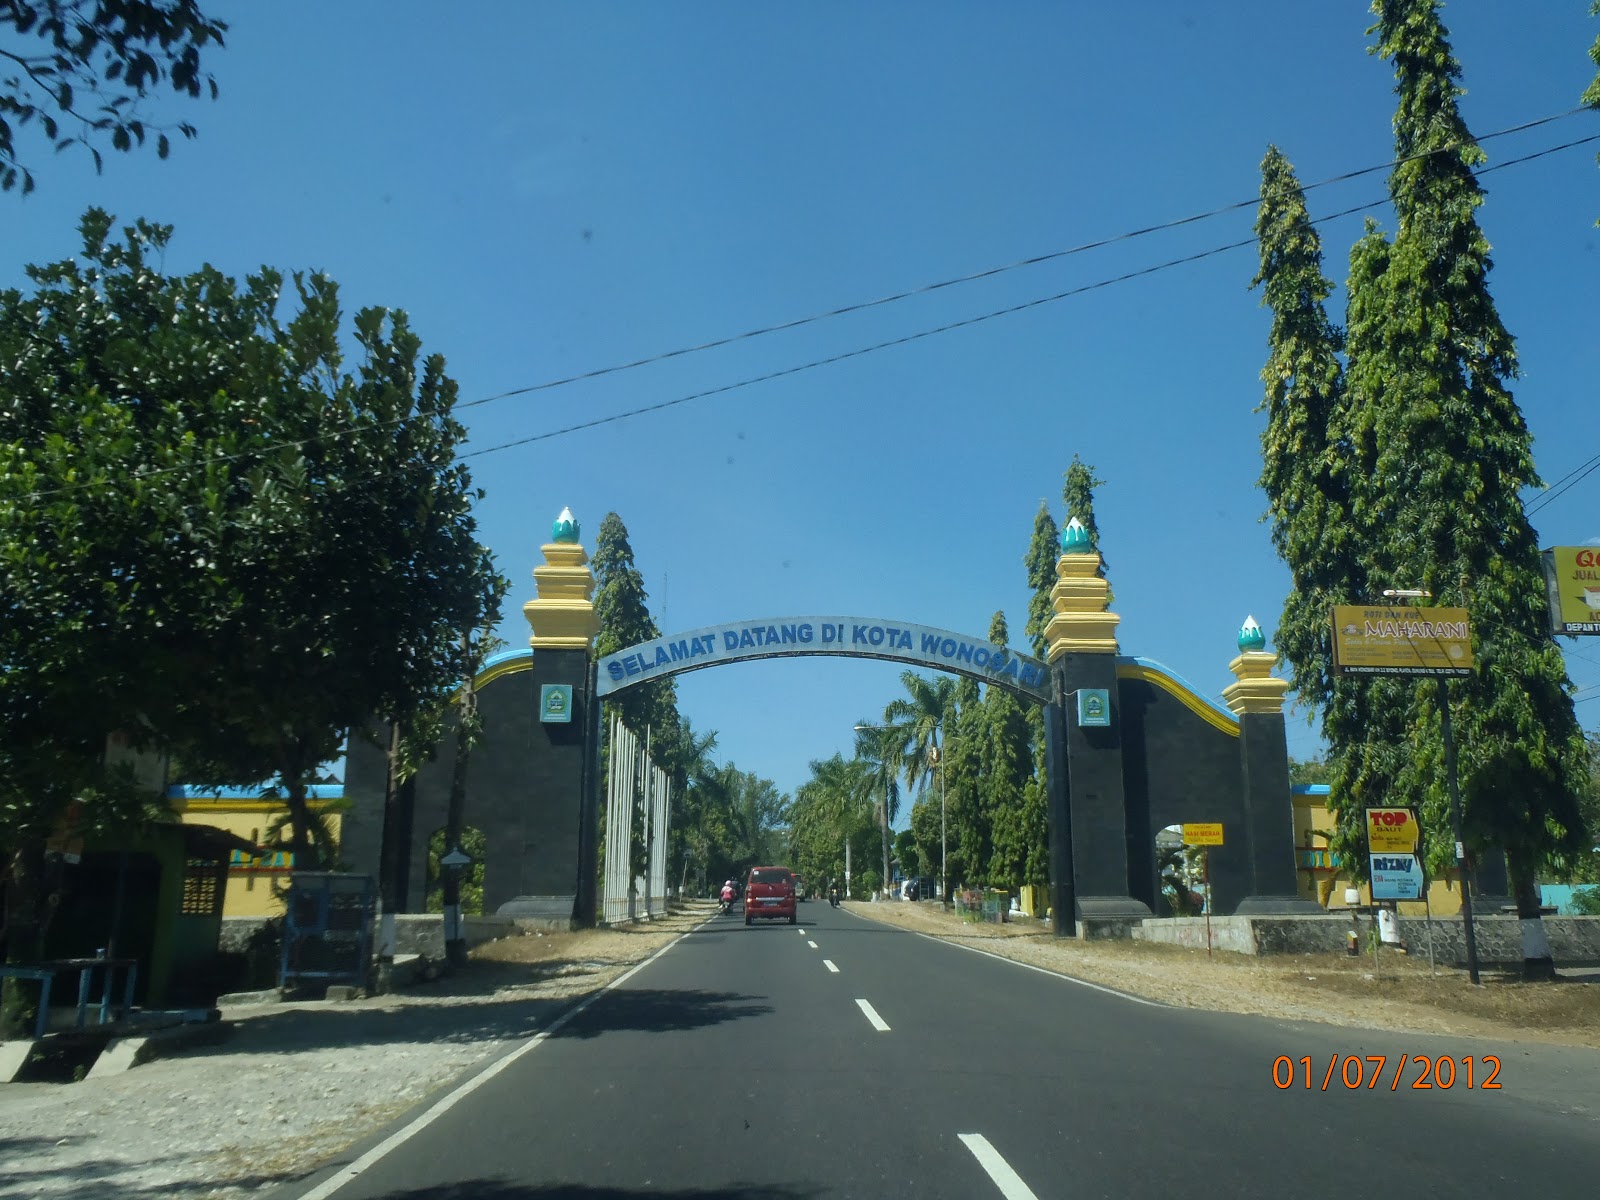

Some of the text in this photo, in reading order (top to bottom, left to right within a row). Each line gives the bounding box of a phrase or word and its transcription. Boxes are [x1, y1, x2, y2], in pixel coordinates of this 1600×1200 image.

[1363, 610, 1420, 620] ROTI DAN KUE
[1364, 620, 1468, 639] MAHARANI
[1566, 623, 1593, 631] DEPAN
[607, 623, 1045, 688] SELAMAT DATANG DI KOTA WONOSARI
[1370, 811, 1407, 826] TOP
